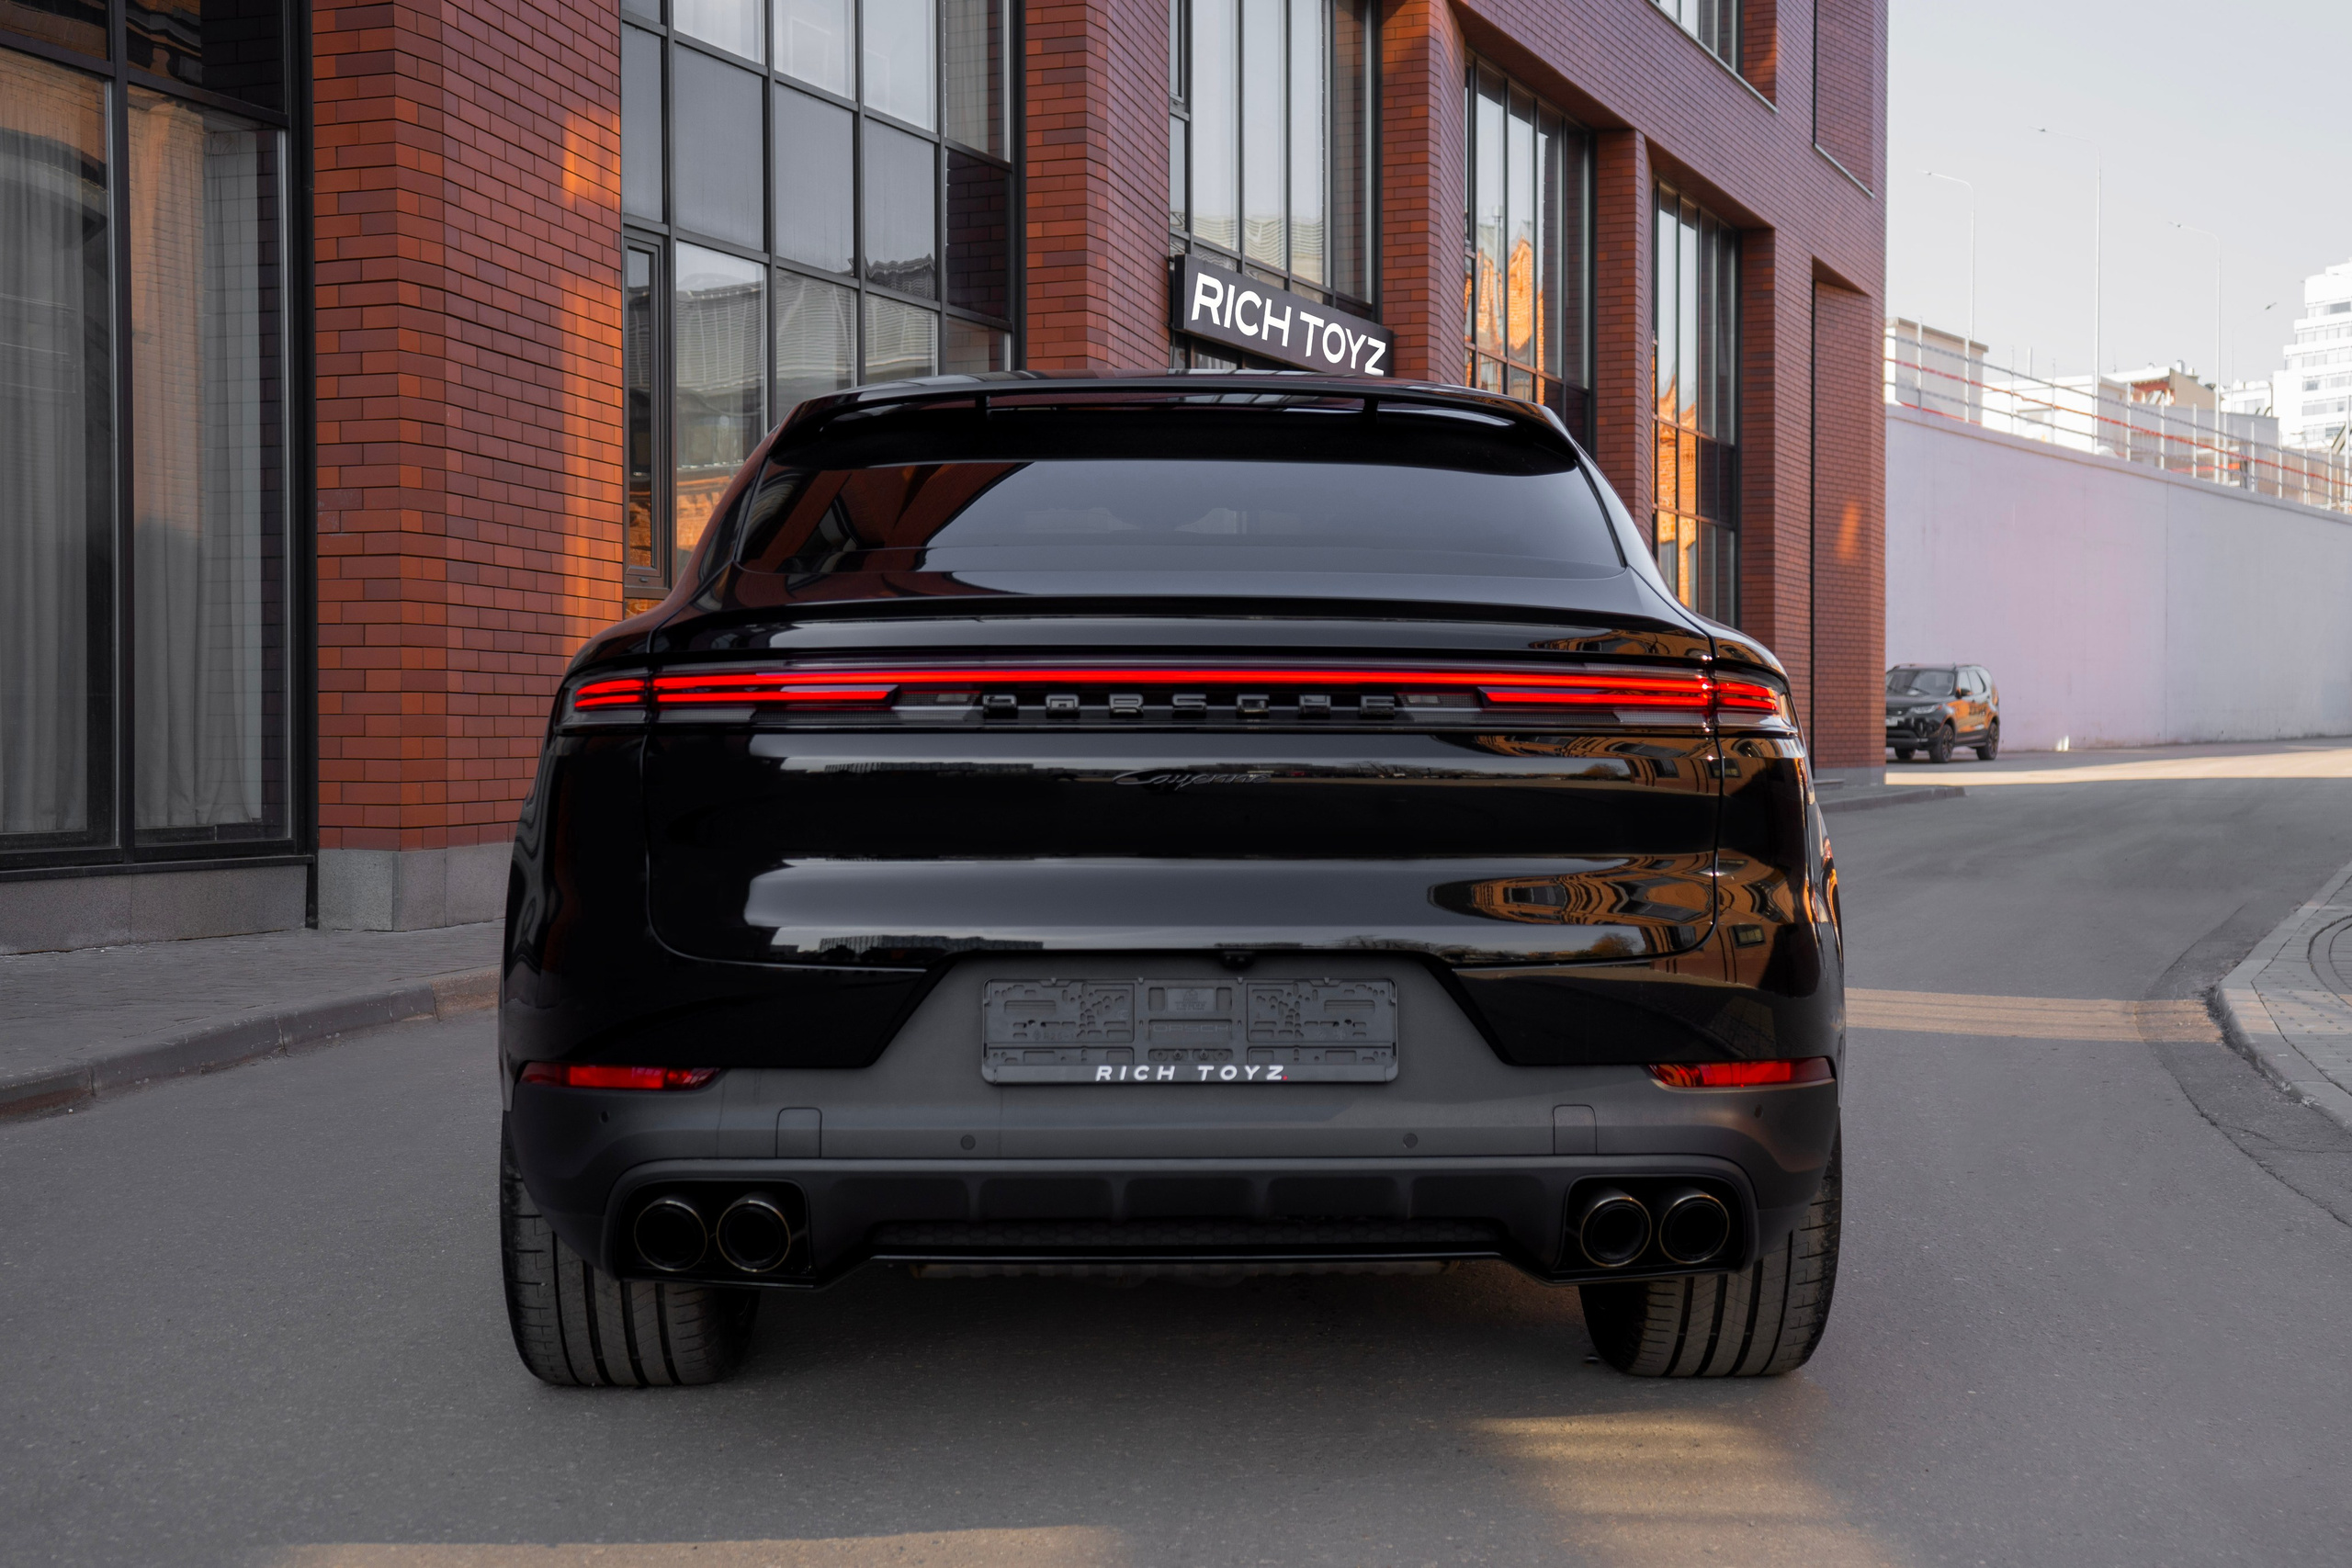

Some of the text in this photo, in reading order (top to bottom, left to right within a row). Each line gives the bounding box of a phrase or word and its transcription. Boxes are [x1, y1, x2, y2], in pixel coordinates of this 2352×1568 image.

[1192, 272, 1386, 376] RICH TOYZ
[983, 694, 1396, 716] PORSCHE
[1112, 768, 1272, 791] Cayenne
[1095, 1066, 1176, 1081] RICH
